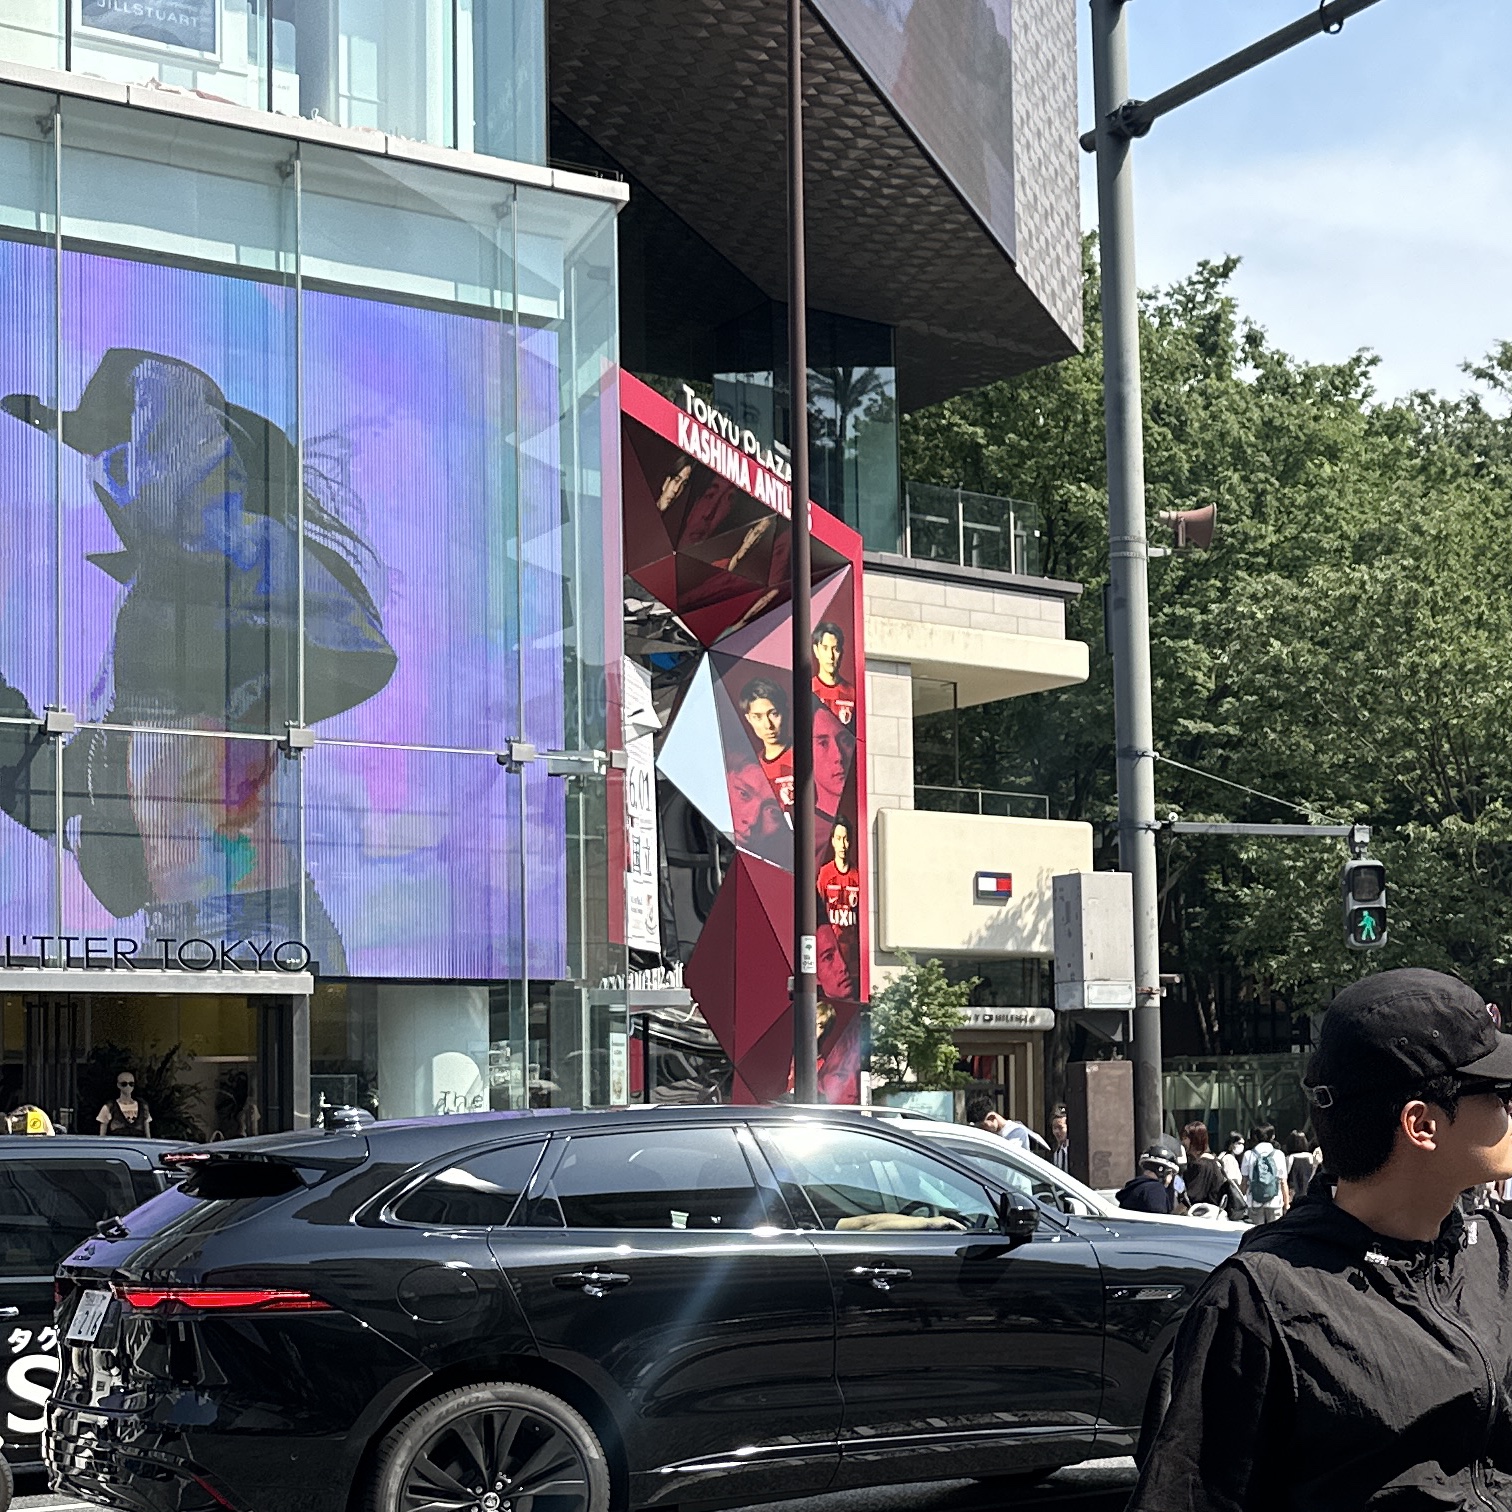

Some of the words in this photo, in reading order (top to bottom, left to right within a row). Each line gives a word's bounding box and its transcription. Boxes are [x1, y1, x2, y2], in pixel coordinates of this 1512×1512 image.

[97, 0, 199, 27] JILLSTUART
[677, 412, 752, 494] KASHIMA
[682, 383, 739, 447] TOKYU
[743, 429, 792, 482] PLAZA
[5, 935, 140, 970] L'TTER
[156, 938, 312, 972] TOKYO
[8, 1326, 58, 1354] タク
[7, 1354, 60, 1434] S
